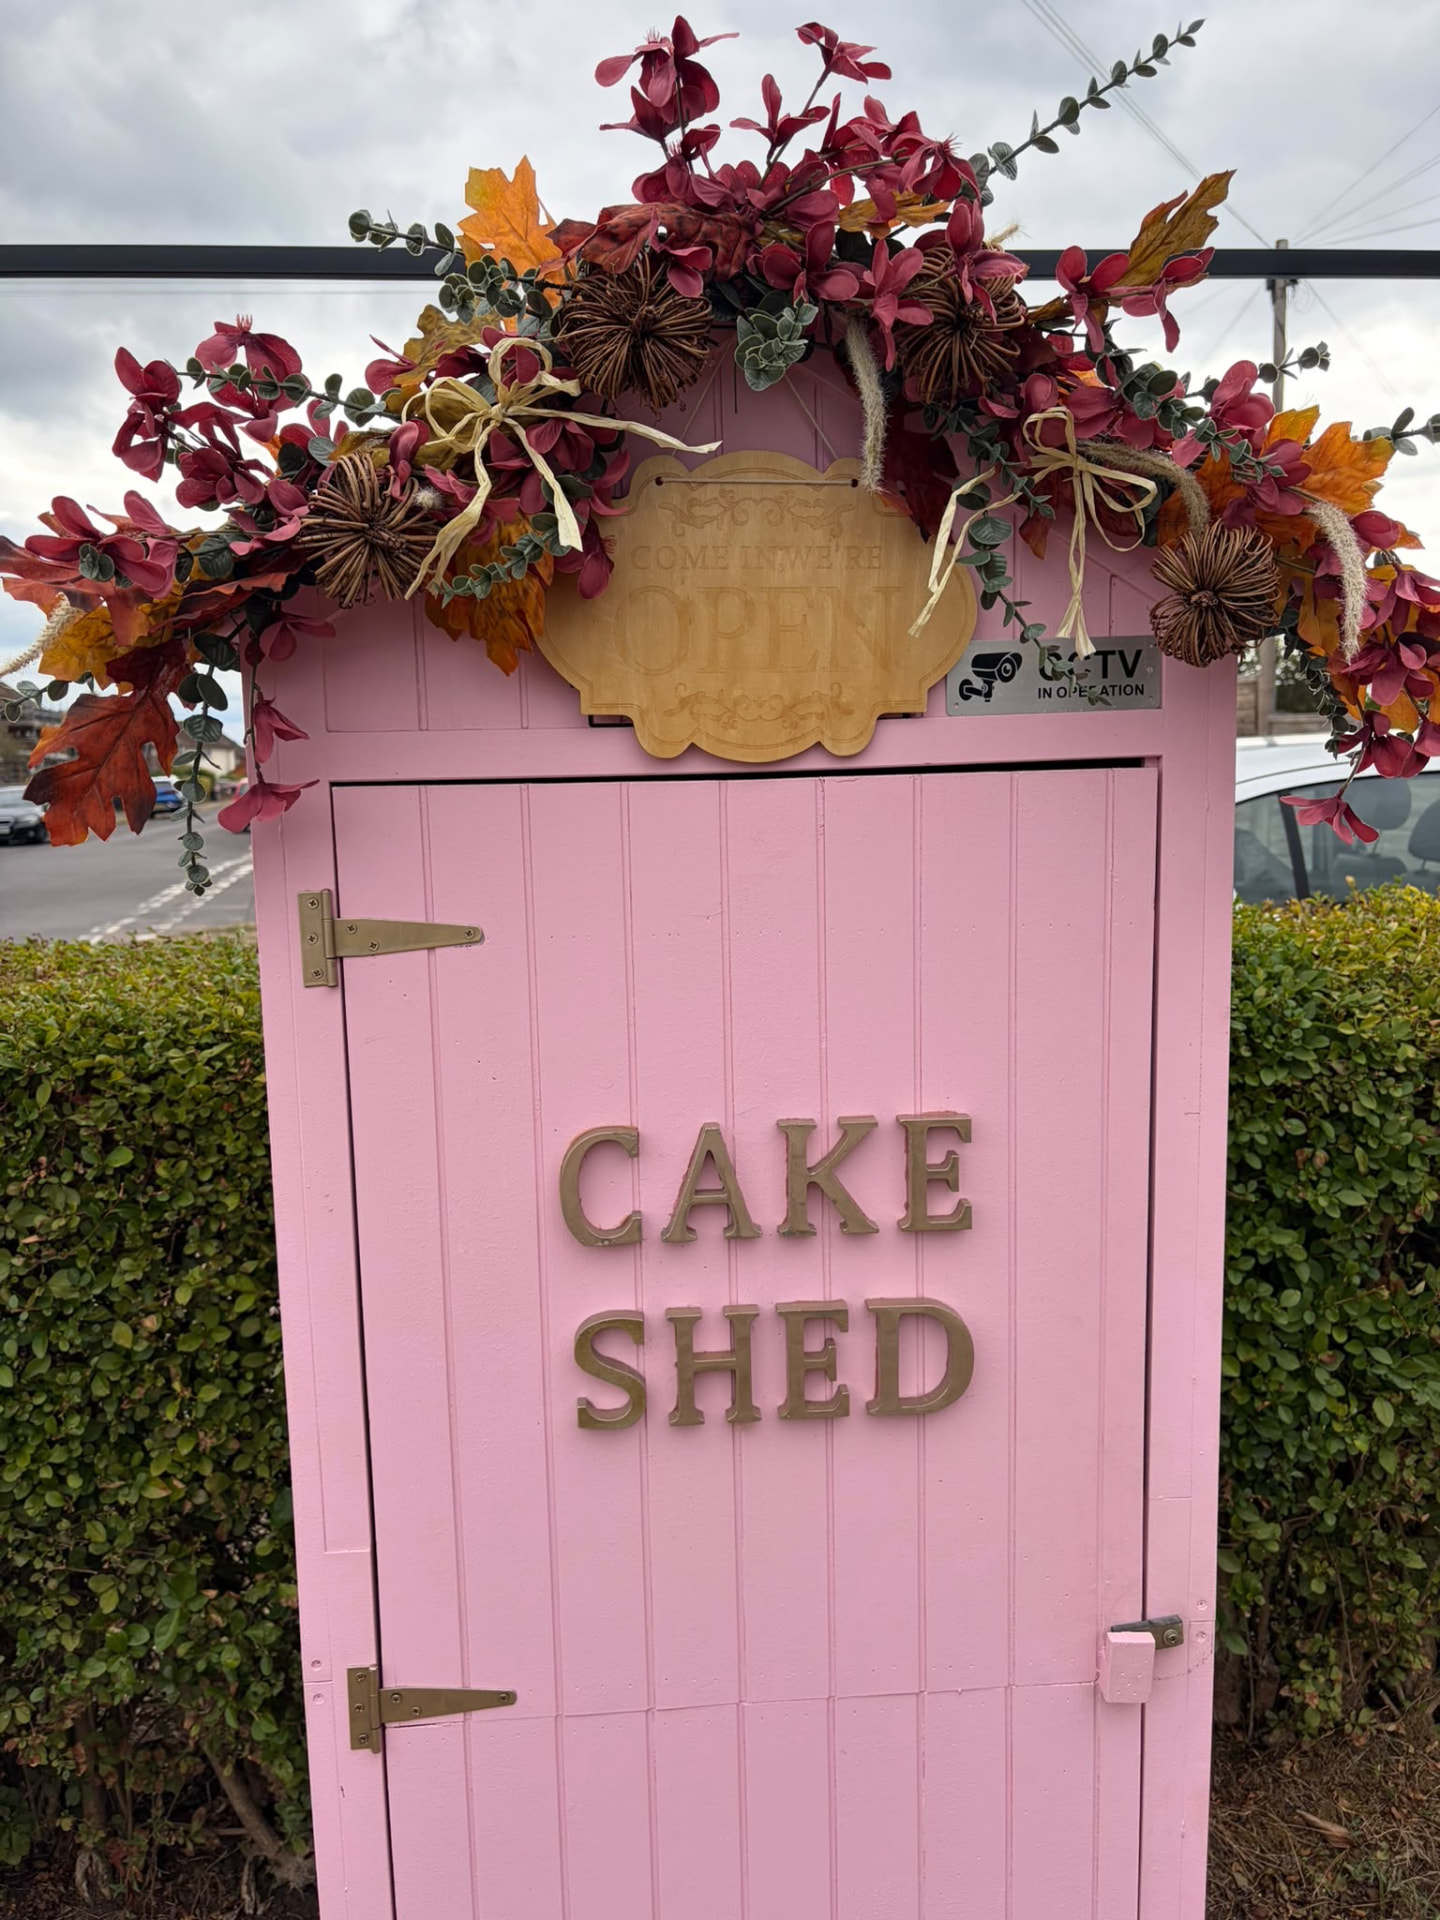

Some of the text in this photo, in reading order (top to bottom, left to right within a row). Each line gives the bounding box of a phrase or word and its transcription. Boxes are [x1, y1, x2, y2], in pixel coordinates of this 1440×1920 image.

[631, 545, 729, 571] COME
[613, 585, 901, 676] OPEN
[1038, 686, 1053, 699] IN
[559, 1111, 973, 1247] CAKE
[574, 1298, 975, 1430] SHED
